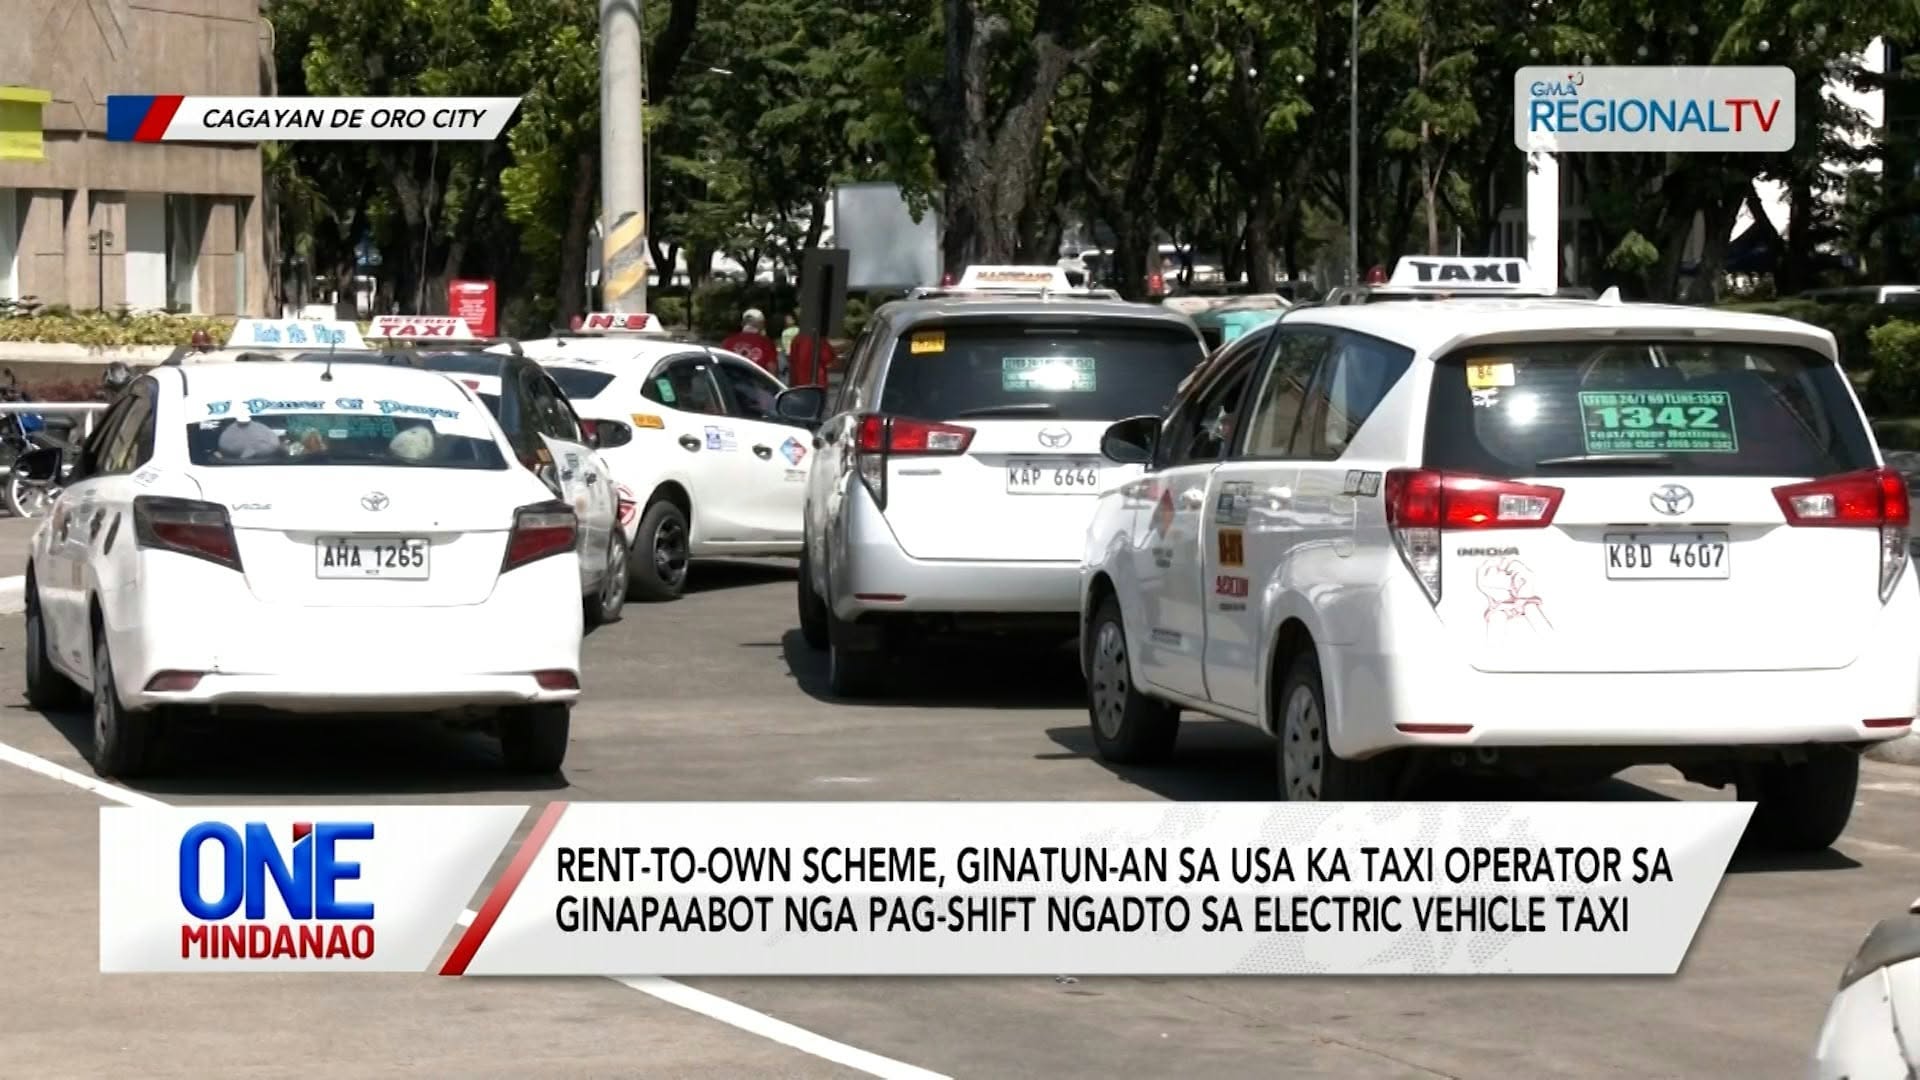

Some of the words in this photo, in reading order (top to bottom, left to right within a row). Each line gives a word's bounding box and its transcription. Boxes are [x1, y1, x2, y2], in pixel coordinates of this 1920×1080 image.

[1408, 261, 1521, 283] TAXI
[380, 325, 456, 336] TAXI
[1594, 406, 1719, 428] 1342
[1009, 467, 1041, 486] KAP
[1054, 467, 1097, 486] 6646
[323, 545, 362, 567] AHA
[374, 545, 424, 567] 1265
[1609, 543, 1652, 568] KBD
[1669, 544, 1726, 568] 4607
